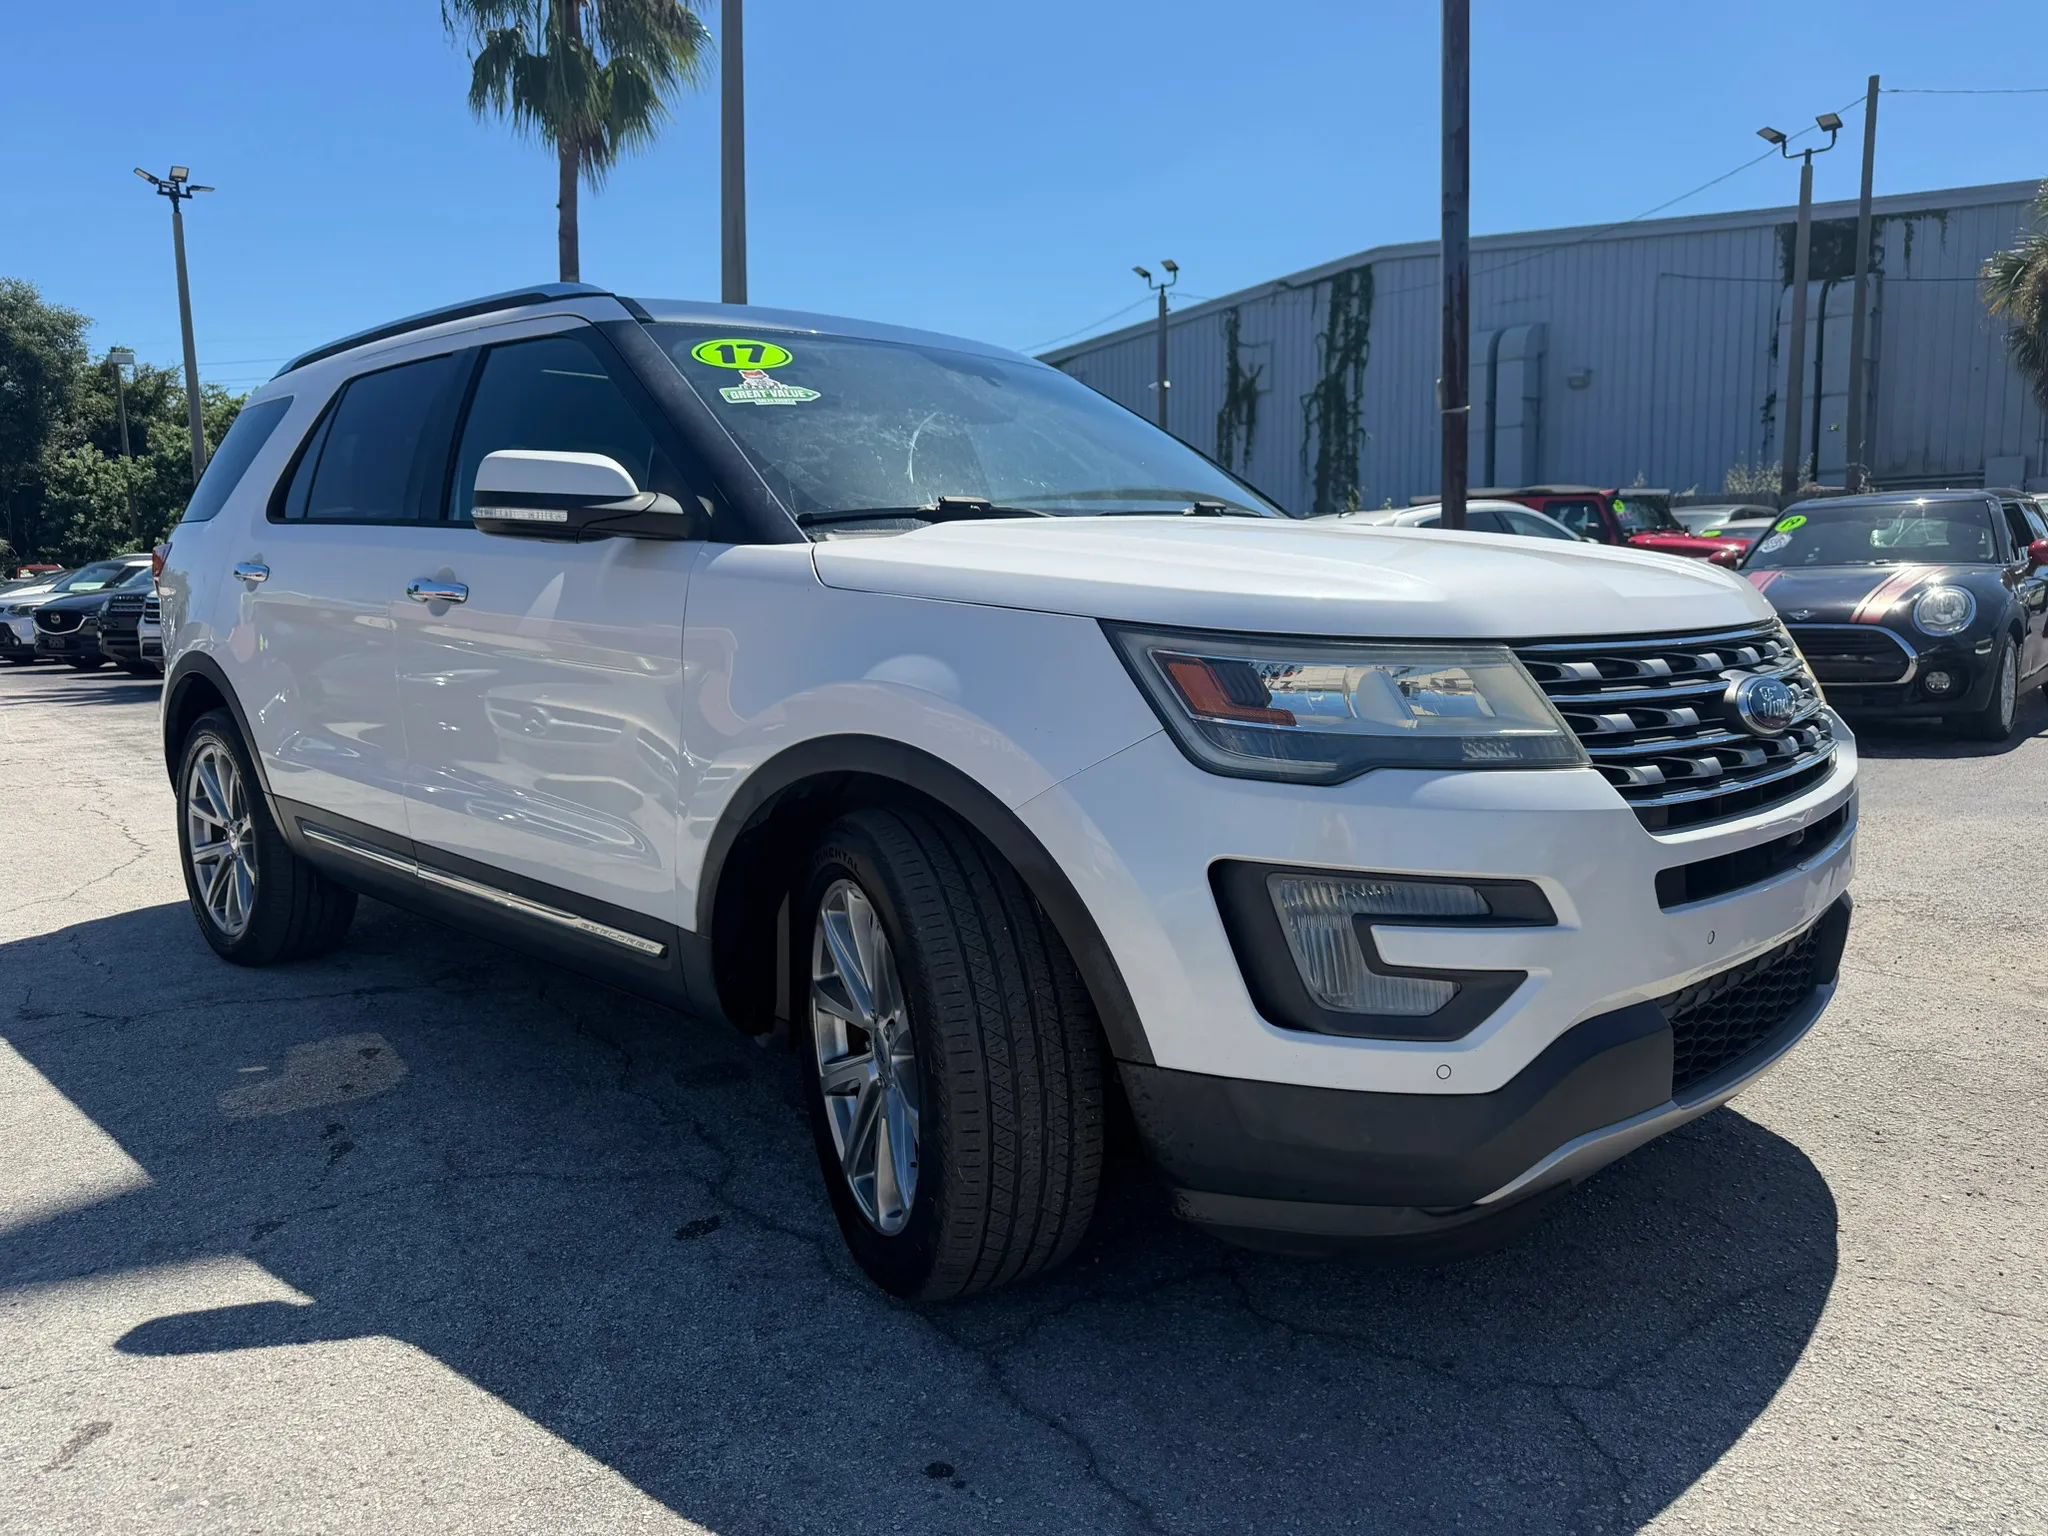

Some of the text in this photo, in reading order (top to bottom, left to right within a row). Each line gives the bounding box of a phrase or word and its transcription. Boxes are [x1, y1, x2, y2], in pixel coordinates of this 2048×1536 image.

[714, 343, 766, 364] 17
[730, 389, 807, 400] GREAT VALUE
[1758, 685, 1793, 718] Ford
